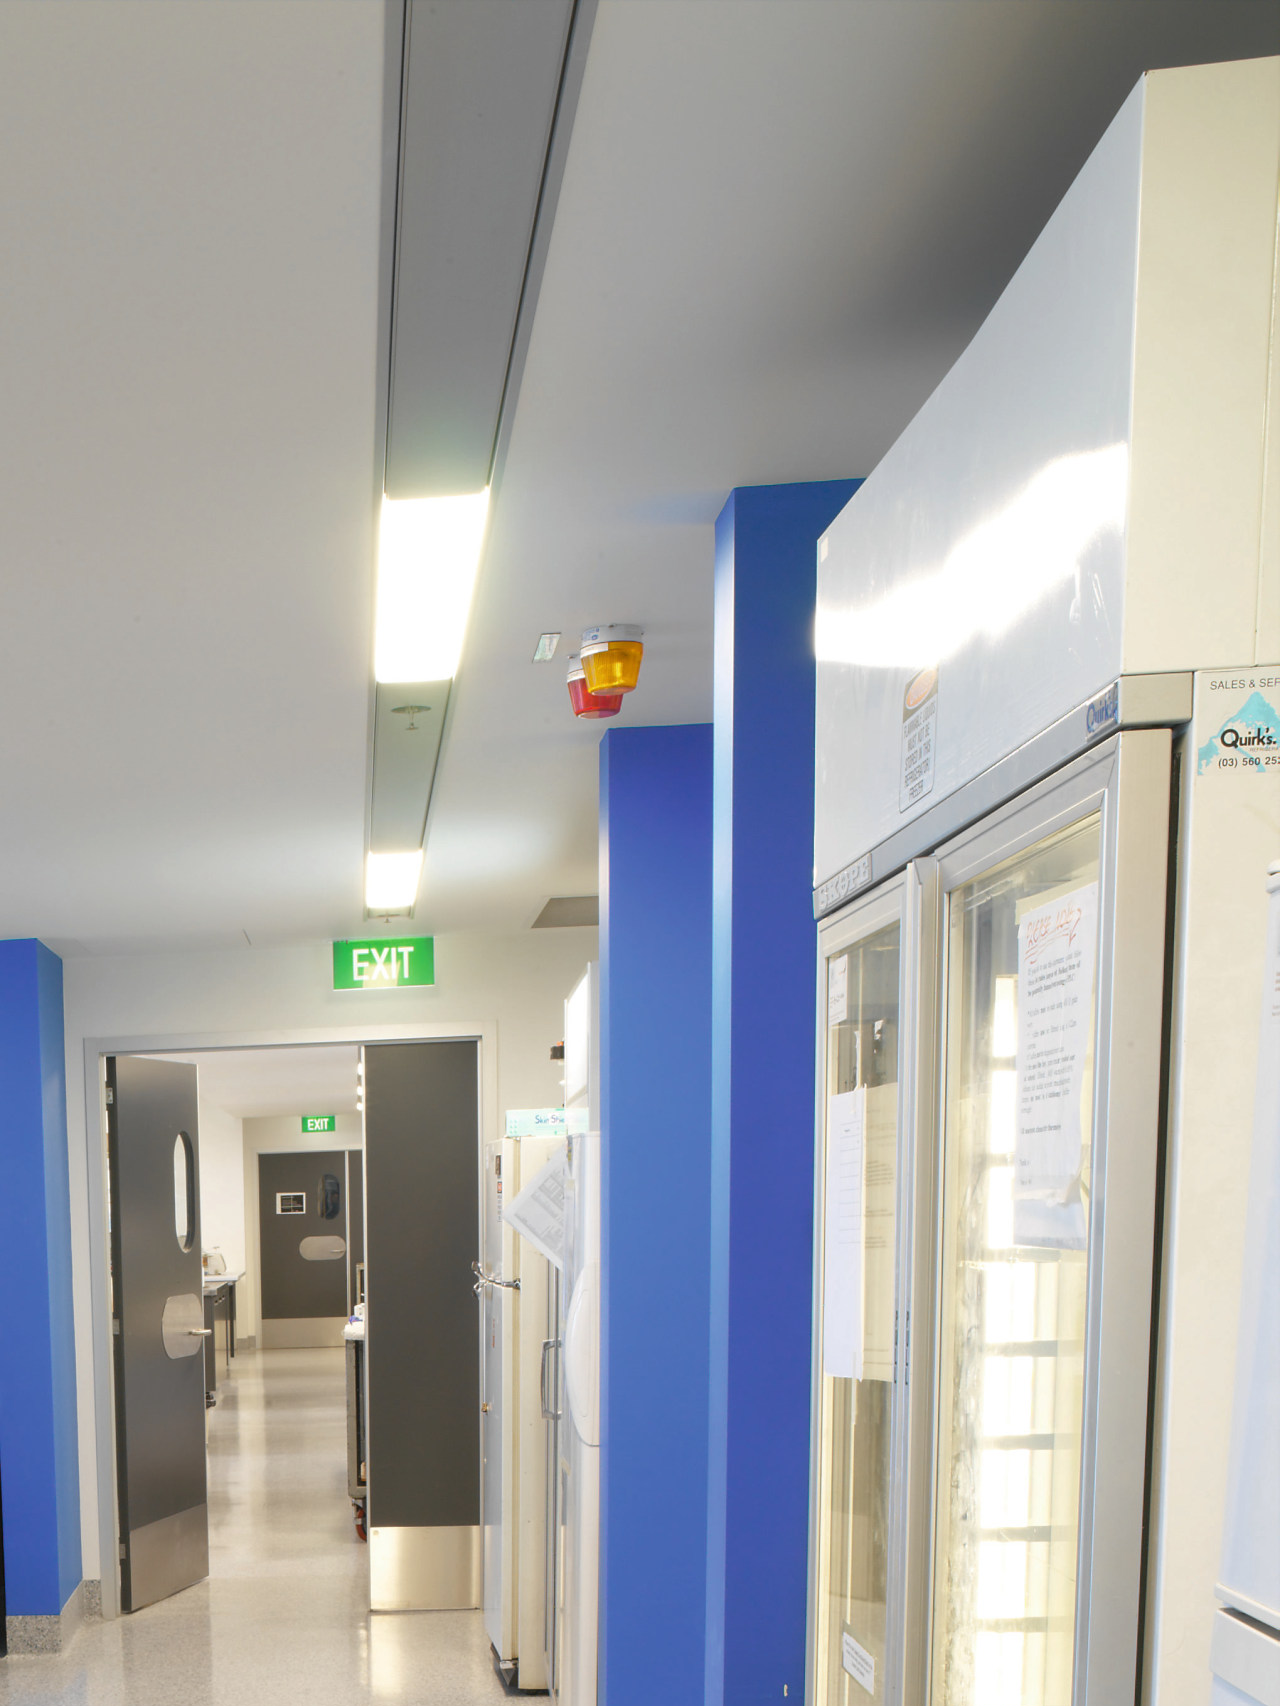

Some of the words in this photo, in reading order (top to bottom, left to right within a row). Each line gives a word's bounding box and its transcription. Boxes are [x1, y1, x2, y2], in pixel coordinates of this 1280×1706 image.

[1210, 679, 1246, 690] SALES
[1249, 679, 1256, 688] &
[904, 711, 923, 739] FLAMMABLE
[1218, 757, 1238, 769] (03)
[1242, 757, 1261, 767] 560
[818, 855, 870, 911] SKOPE
[352, 946, 415, 982] EXIT
[307, 1118, 329, 1131] EXIT
